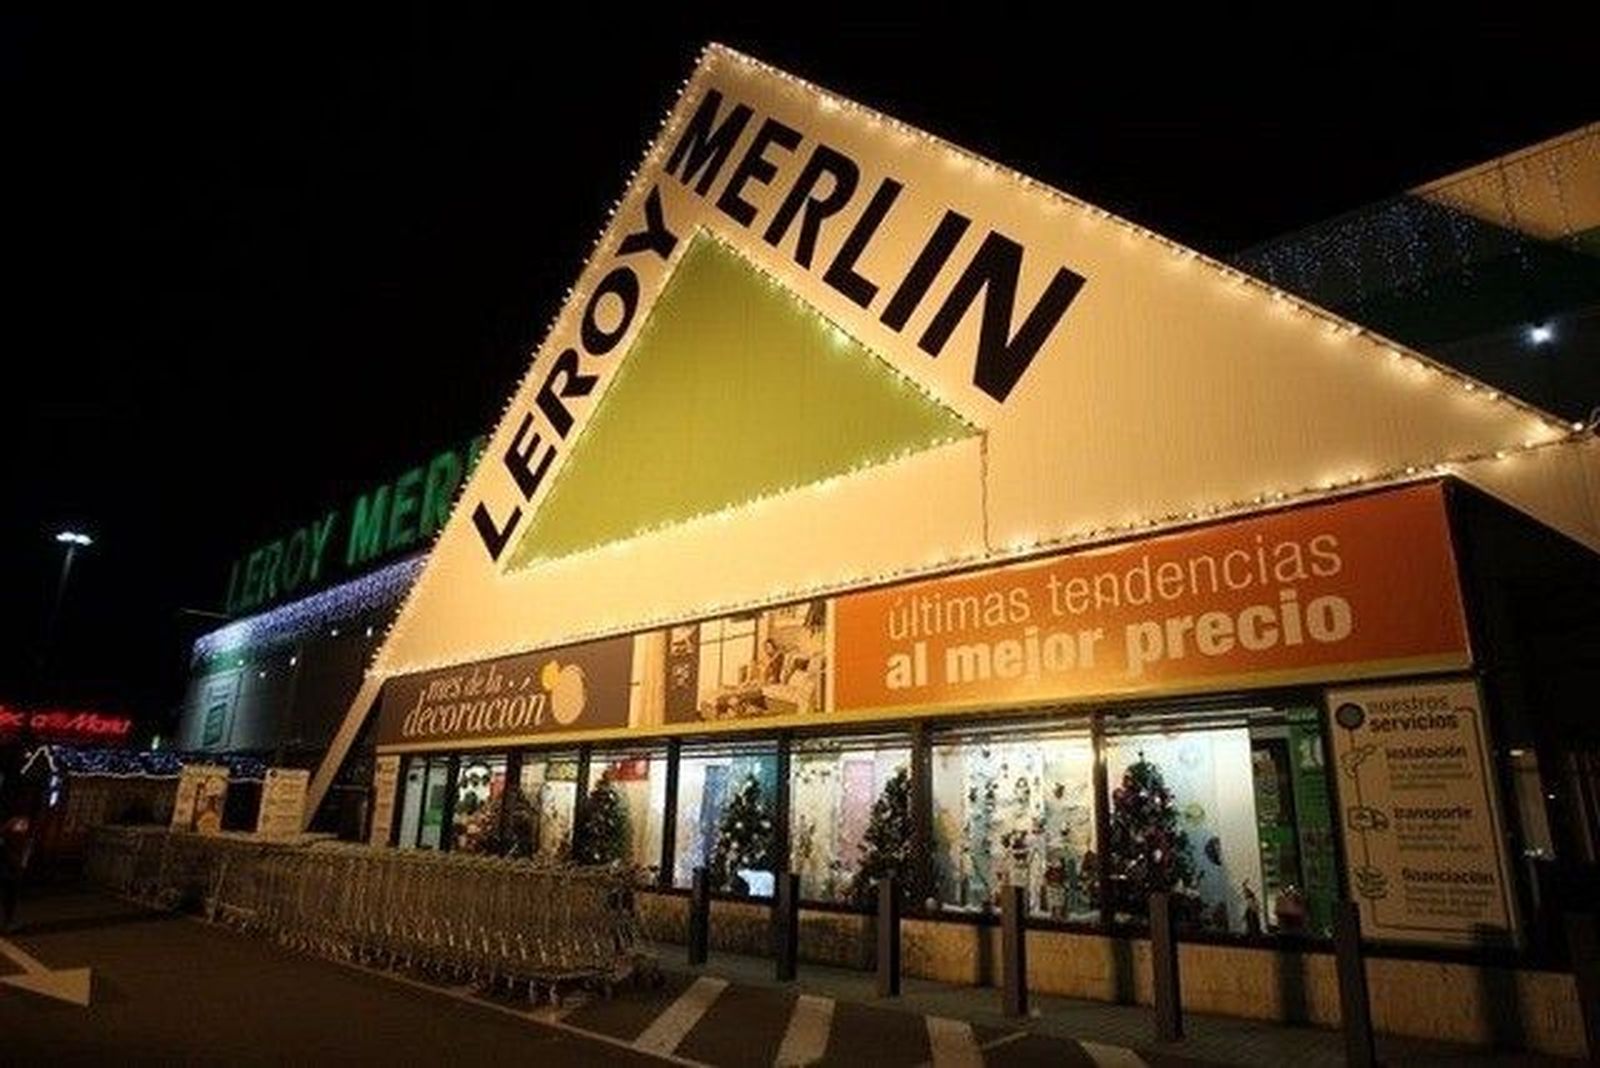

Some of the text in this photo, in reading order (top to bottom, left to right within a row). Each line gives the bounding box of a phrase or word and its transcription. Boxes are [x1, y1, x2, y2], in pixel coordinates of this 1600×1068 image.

[473, 88, 1088, 561] LEROY MERLIN
[224, 508, 342, 614] LEROY
[888, 533, 1342, 641] últimas tendencias
[886, 588, 1352, 690] al mejor precio
[1366, 694, 1448, 715] nuestros
[1369, 712, 1458, 734] servicios
